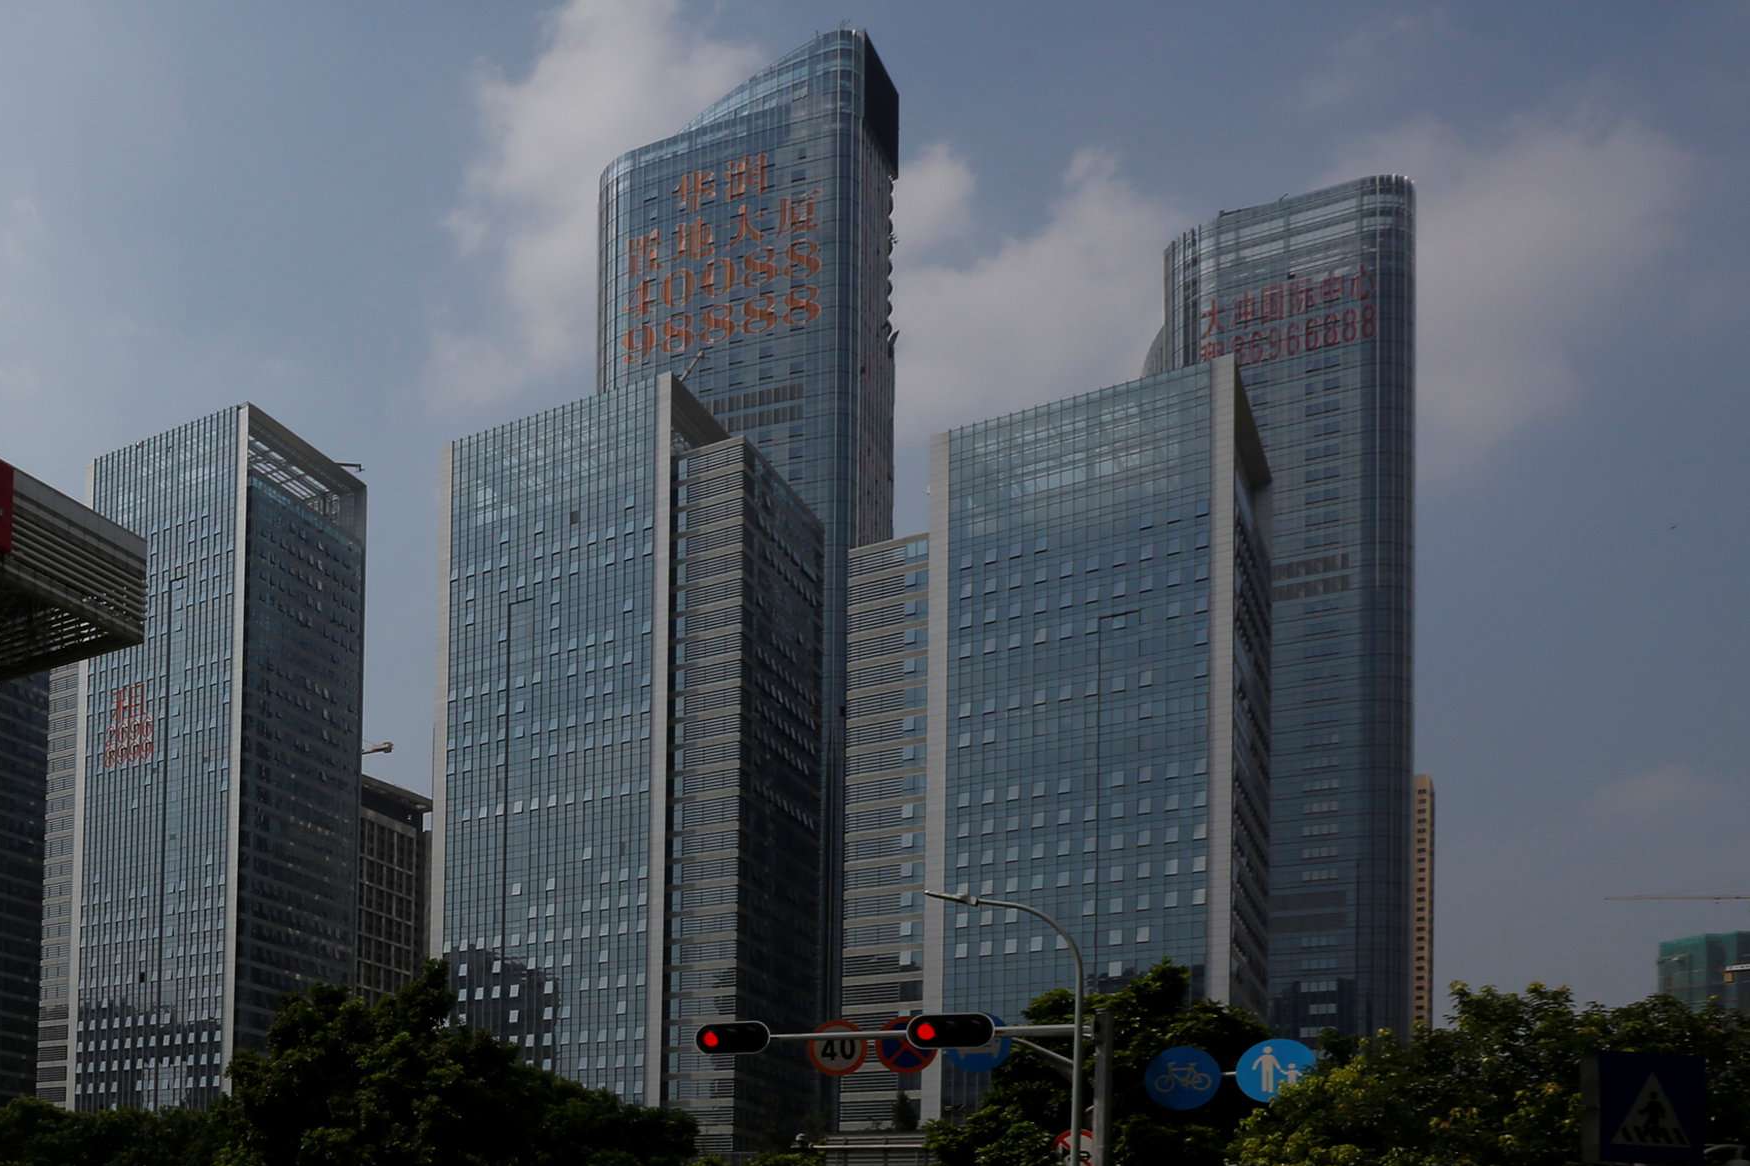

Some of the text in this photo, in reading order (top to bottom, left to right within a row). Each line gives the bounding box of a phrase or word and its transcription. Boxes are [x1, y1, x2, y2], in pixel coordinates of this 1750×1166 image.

[672, 150, 767, 213] 华润
[626, 187, 824, 276] 置地大厦
[621, 238, 822, 320] 40088
[621, 284, 822, 364] 98888
[821, 1039, 856, 1061] 40
